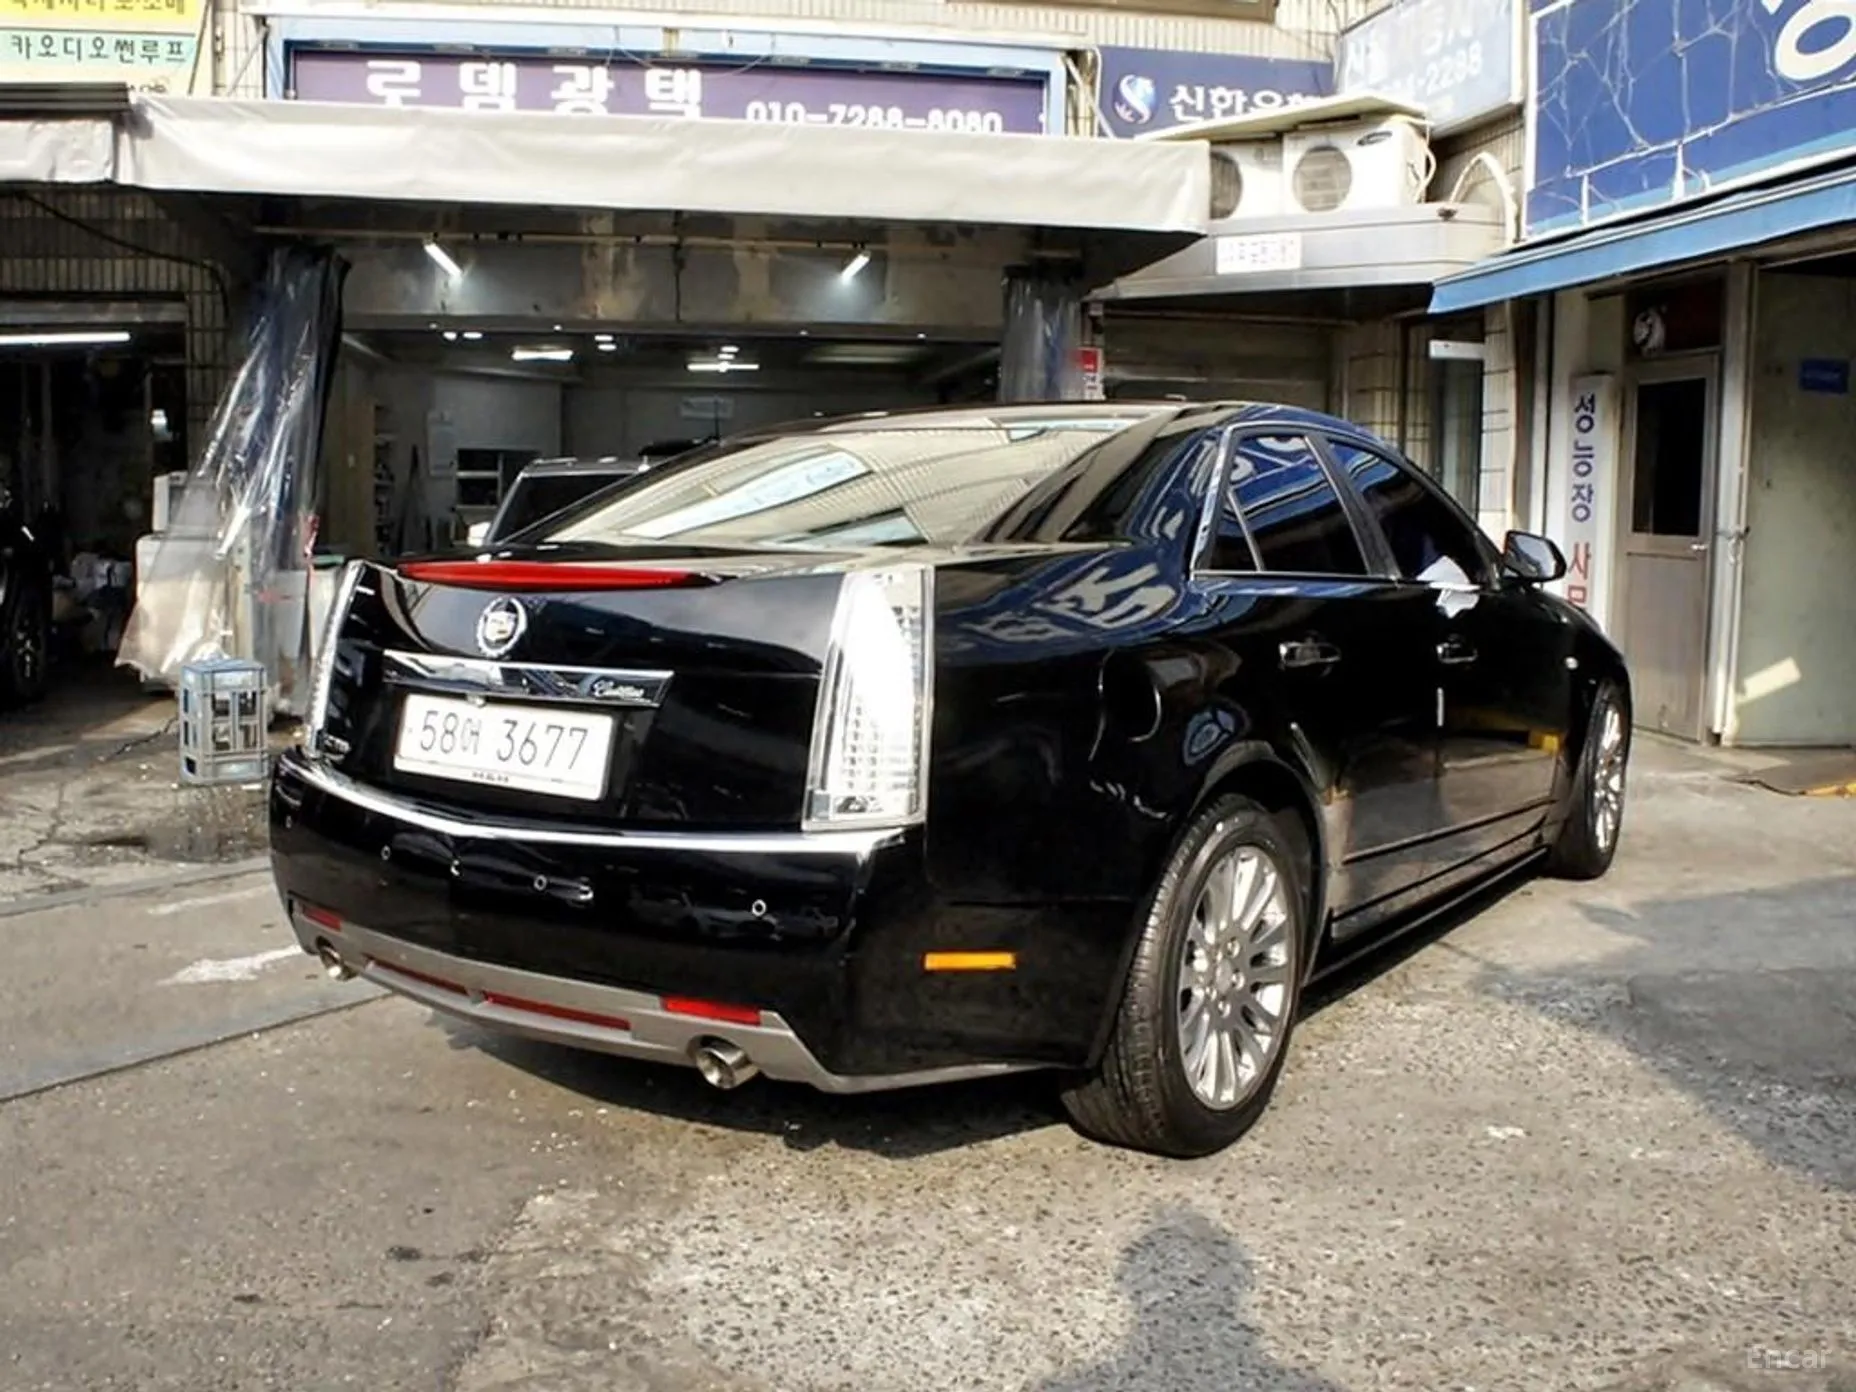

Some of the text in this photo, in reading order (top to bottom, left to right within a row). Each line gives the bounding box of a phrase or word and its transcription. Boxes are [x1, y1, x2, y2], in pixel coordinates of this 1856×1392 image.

[11, 34, 187, 64] 카오디오썬루프
[420, 709, 588, 770] 58어 3677
